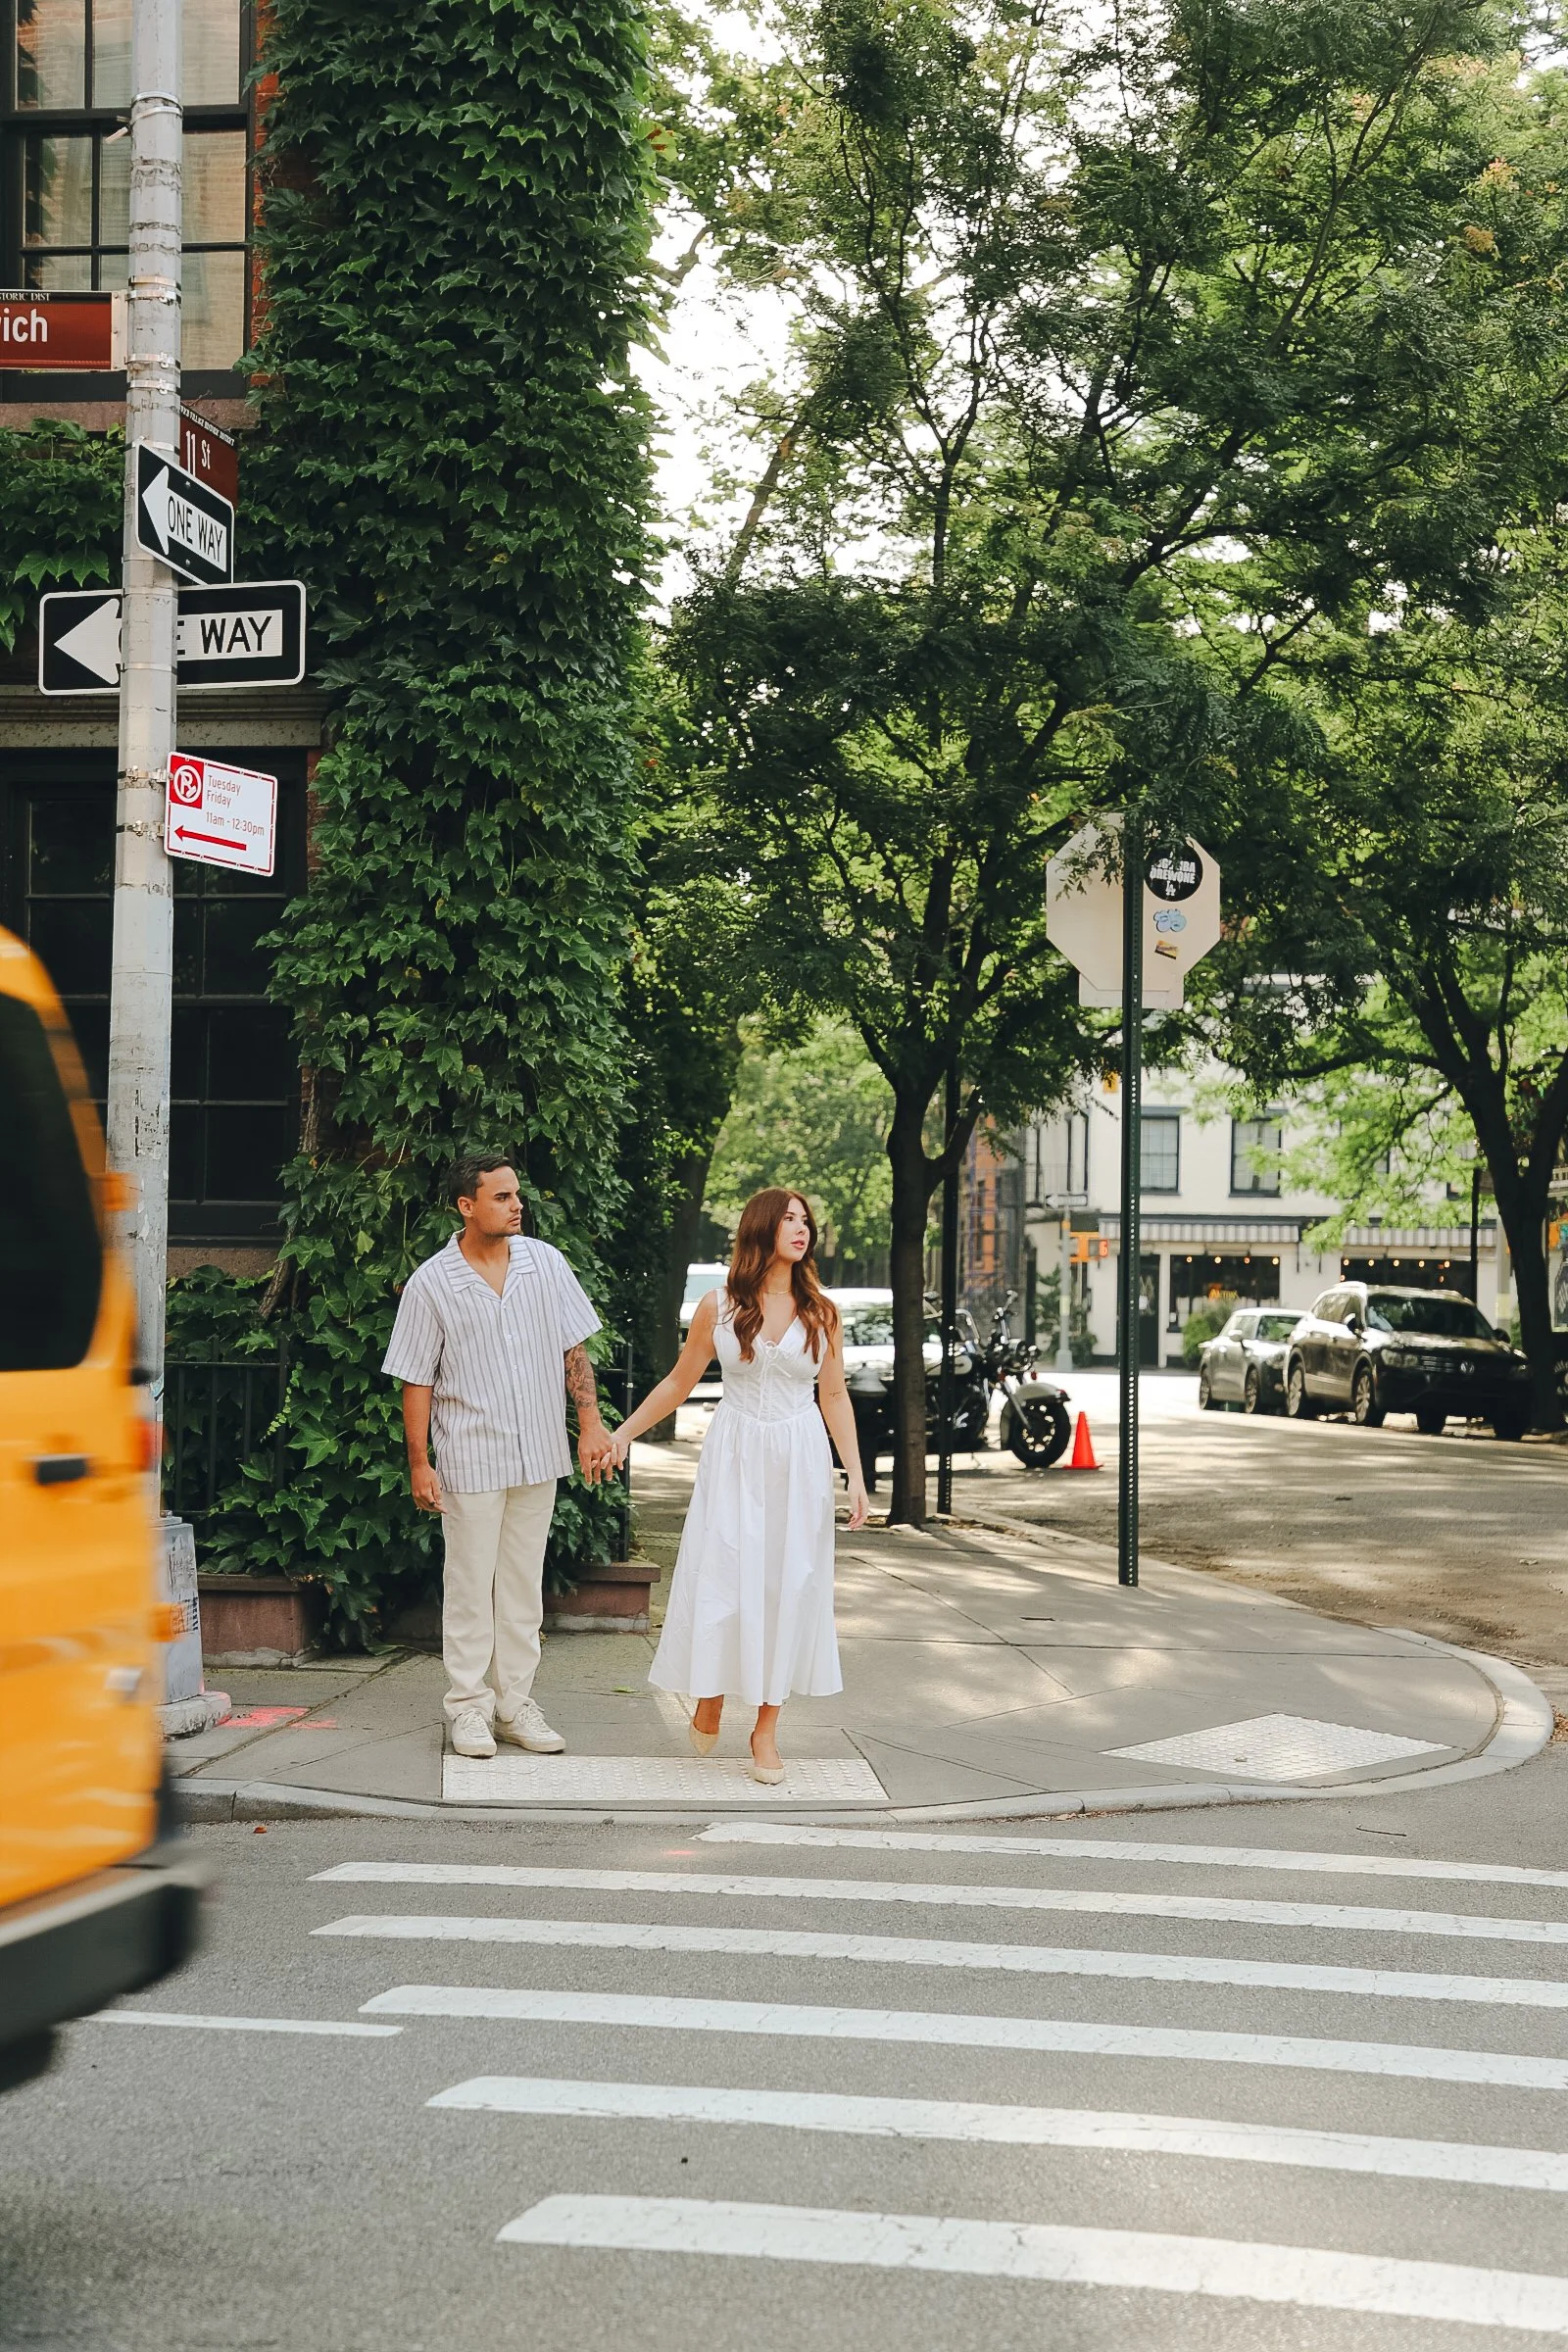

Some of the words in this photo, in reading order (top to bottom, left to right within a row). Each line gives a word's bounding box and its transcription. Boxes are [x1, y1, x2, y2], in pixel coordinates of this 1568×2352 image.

[0, 292, 27, 301] TORIC
[30, 292, 50, 302] DIST
[0, 307, 48, 343] ich
[185, 430, 196, 478] 11
[201, 439, 211, 470] St
[168, 495, 193, 545] ONE
[198, 514, 223, 562] WAY
[200, 615, 272, 655] WAY
[206, 789, 232, 808] Friday
[208, 774, 241, 796] Tuesday
[206, 811, 225, 827] 11am
[231, 817, 265, 836] 12:30pm
